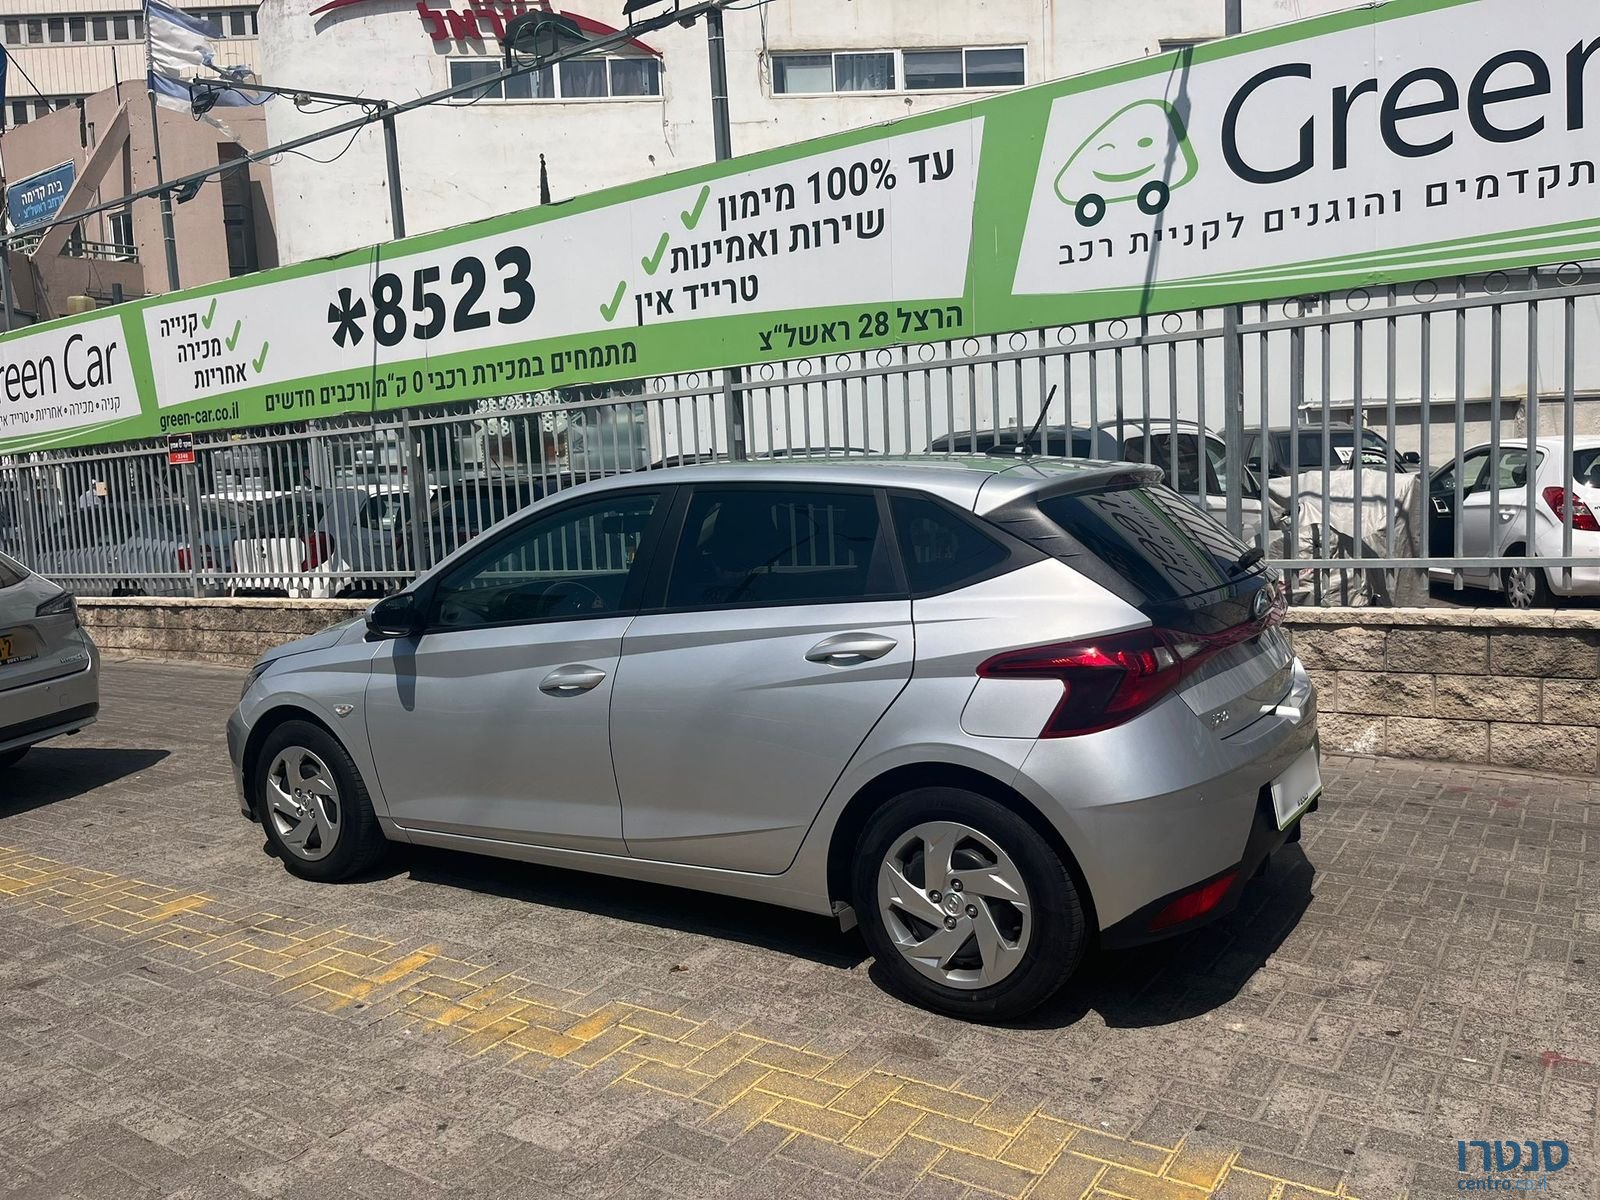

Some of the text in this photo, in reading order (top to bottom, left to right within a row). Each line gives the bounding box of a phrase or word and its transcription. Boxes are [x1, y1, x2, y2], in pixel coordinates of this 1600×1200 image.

[21, 180, 64, 205] בית קדימה
[717, 148, 955, 232] עד 100% מימון
[1264, 188, 1401, 234] והוגנים
[669, 207, 885, 274] שירות ואמינות
[1128, 211, 1245, 256] לקניית
[1058, 236, 1113, 266] רכב
[634, 274, 759, 326] טרייד אין
[160, 312, 198, 338] קנייה
[858, 311, 889, 339] 28
[897, 305, 963, 333] הרצל
[63, 333, 117, 390] Car
[177, 337, 222, 363] מכירה
[551, 341, 637, 373] מתמחים
[194, 361, 248, 389] אחריות
[412, 371, 423, 393] 0
[428, 366, 467, 391] רכבי
[472, 354, 545, 385] במכירת
[70, 401, 94, 416] מכירה
[101, 396, 121, 413] קניה
[265, 388, 316, 411] חדשים
[320, 384, 372, 405] ורכבים
[10, 411, 30, 425] טרייד
[35, 405, 63, 421] אחריות
[160, 401, 240, 432] green-car.co.il
